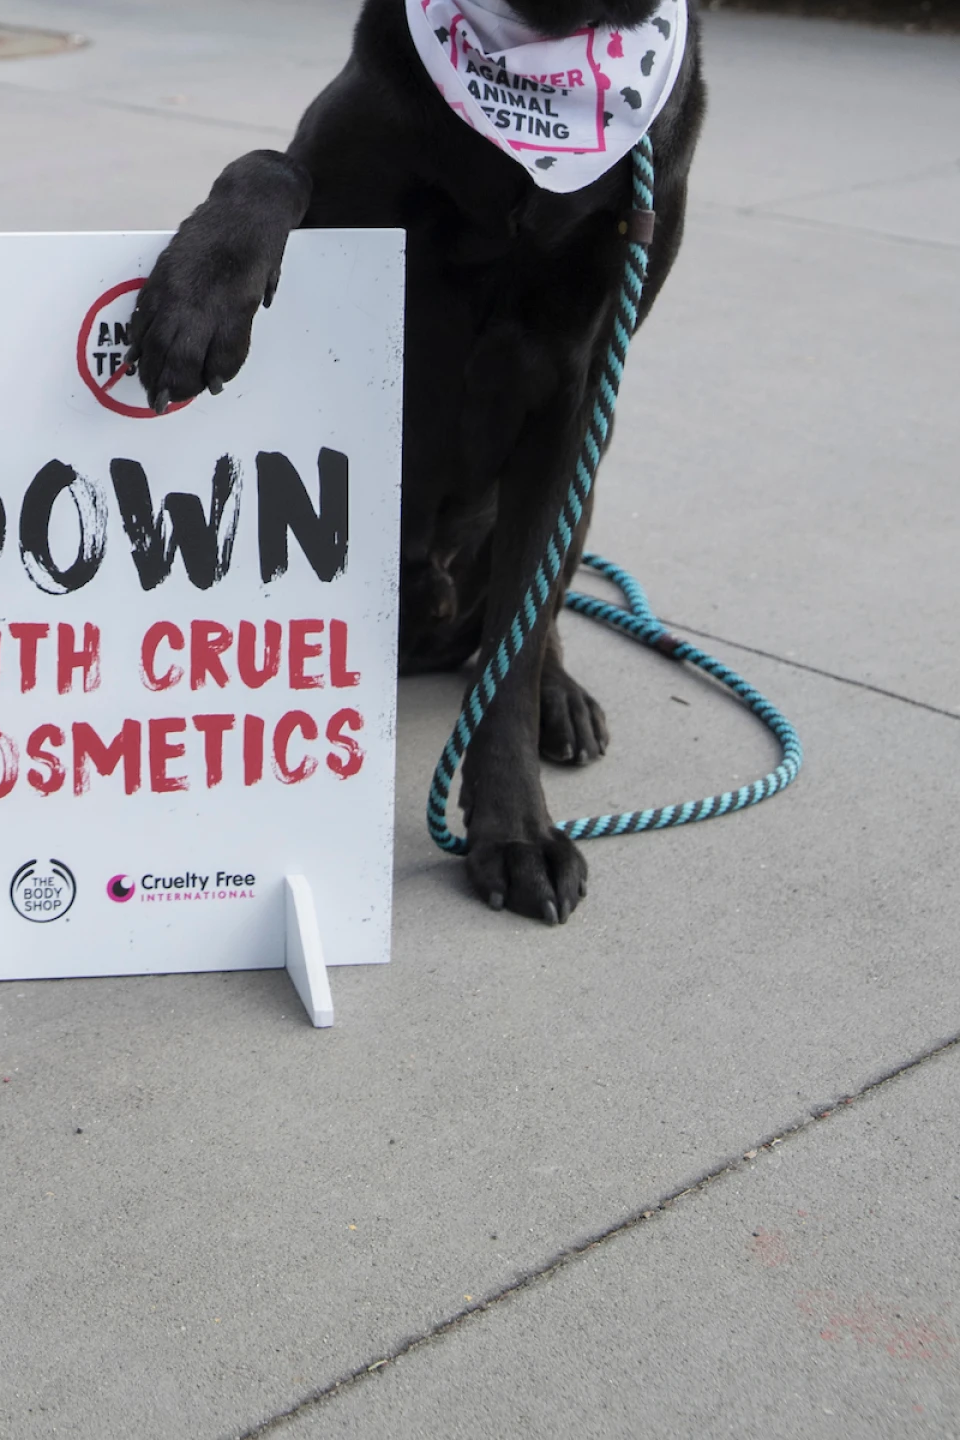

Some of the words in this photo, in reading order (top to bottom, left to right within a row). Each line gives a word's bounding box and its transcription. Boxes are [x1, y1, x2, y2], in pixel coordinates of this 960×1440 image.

[467, 79, 559, 118] ANIMAL
[140, 618, 362, 692] CRUEL
[32, 876, 55, 887] THE
[141, 871, 210, 891] Cruelty
[216, 871, 256, 887] Free
[23, 887, 63, 900] BODY
[140, 890, 256, 902] INTERNATIONAL
[24, 899, 62, 912] SHOP
